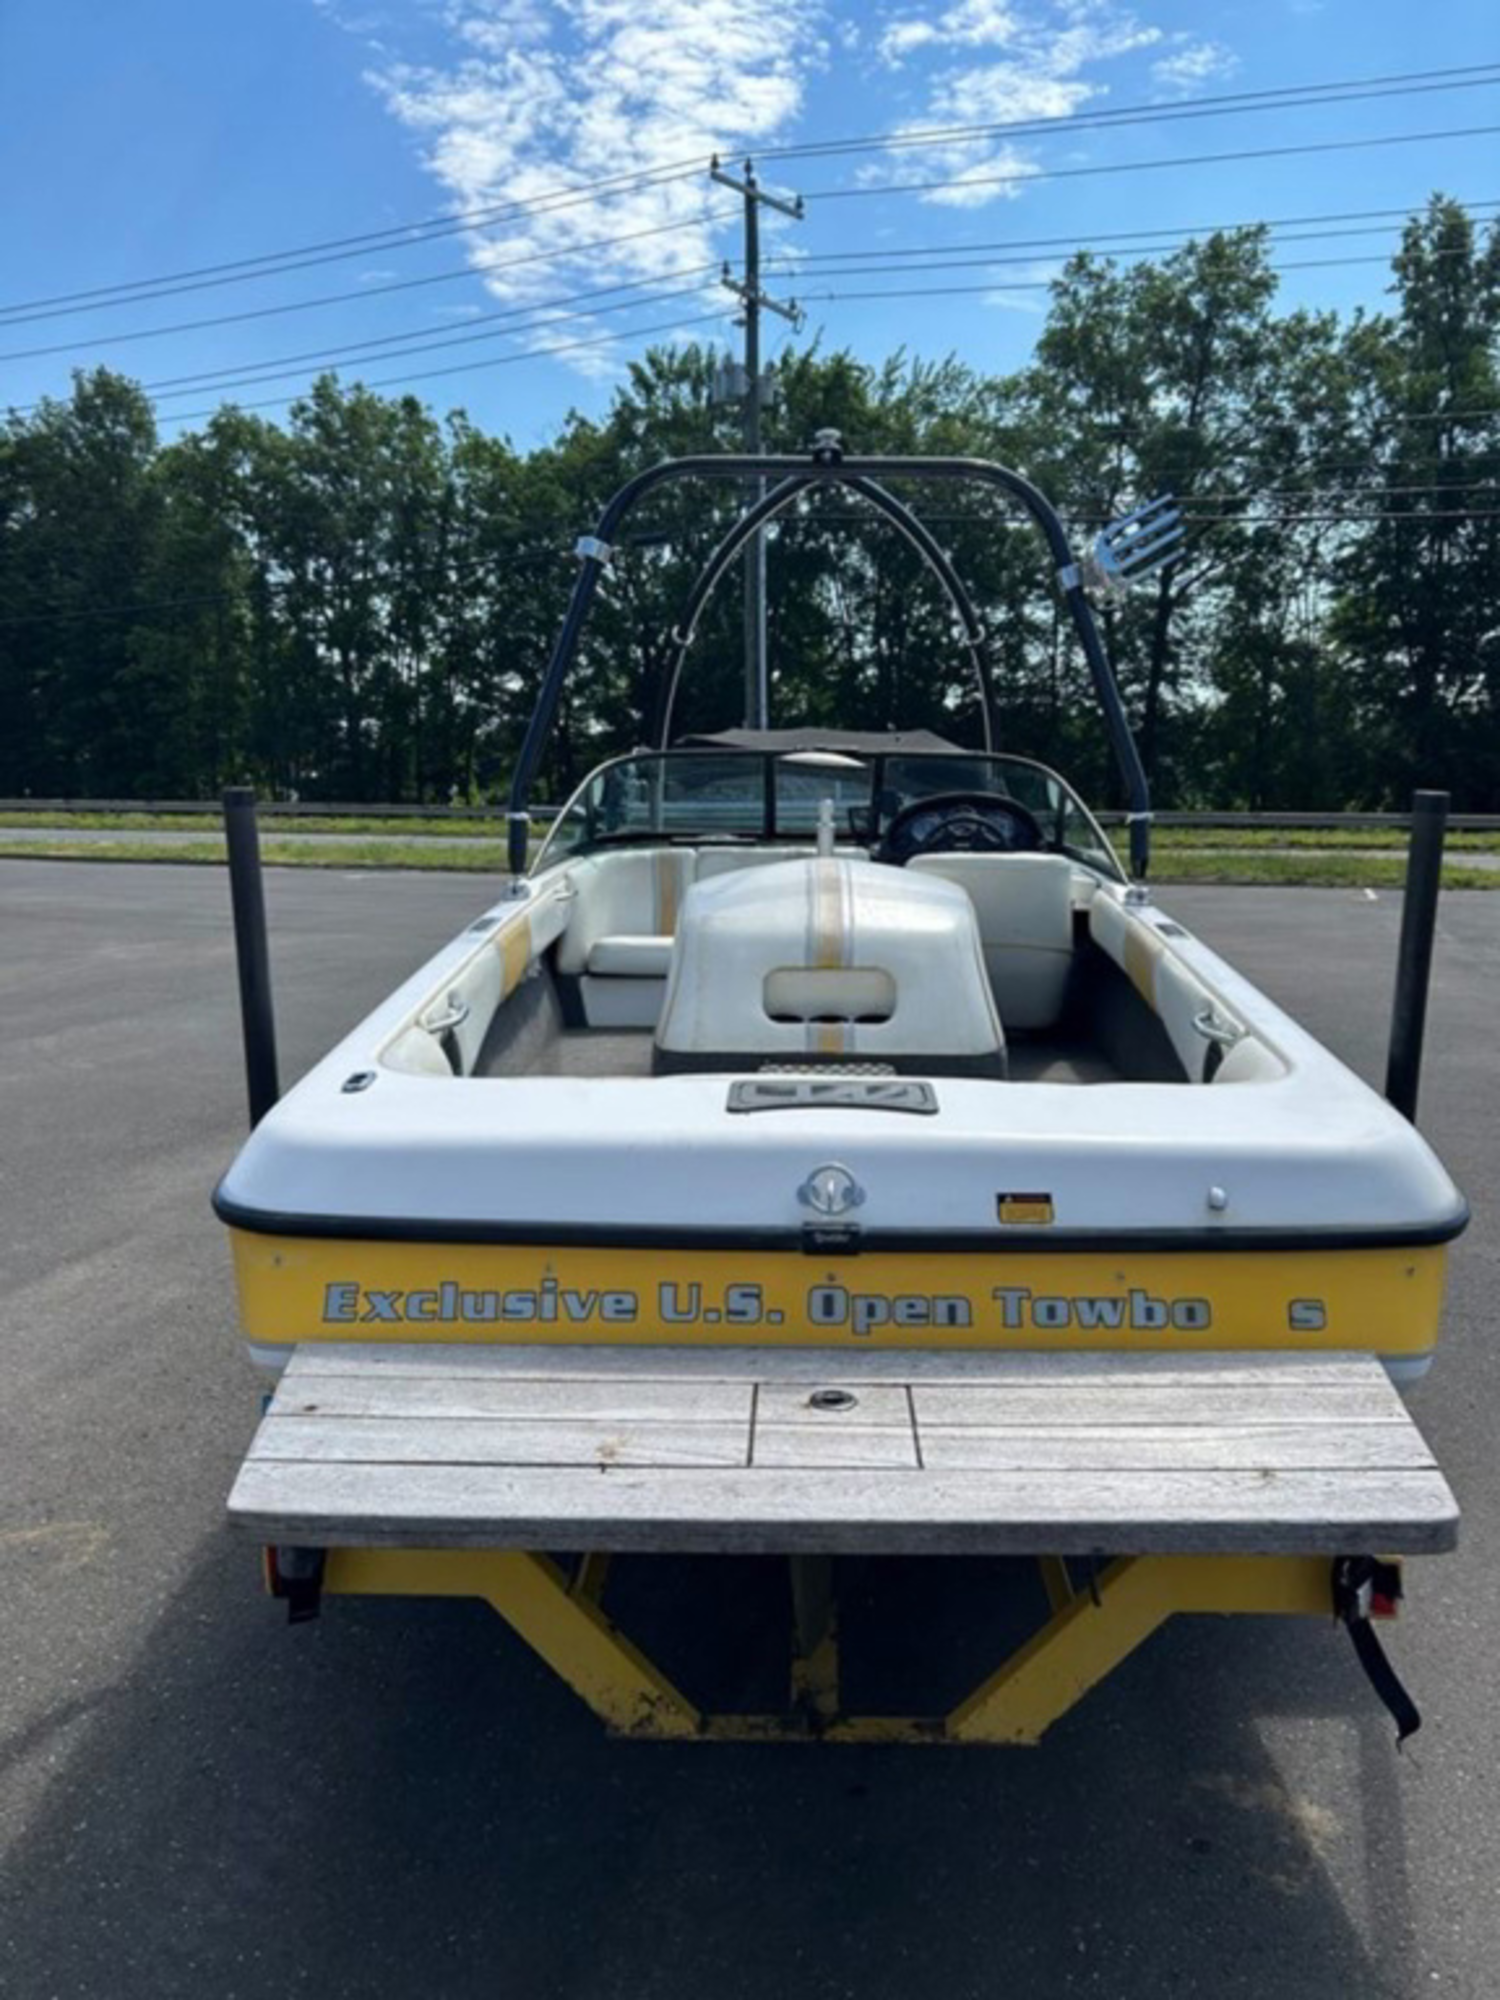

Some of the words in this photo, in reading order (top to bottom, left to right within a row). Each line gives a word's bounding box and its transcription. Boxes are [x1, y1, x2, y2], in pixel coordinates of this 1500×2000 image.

[322, 1279, 638, 1323] Exclusive
[657, 1282, 786, 1324] U.S.
[807, 1284, 973, 1335] Open
